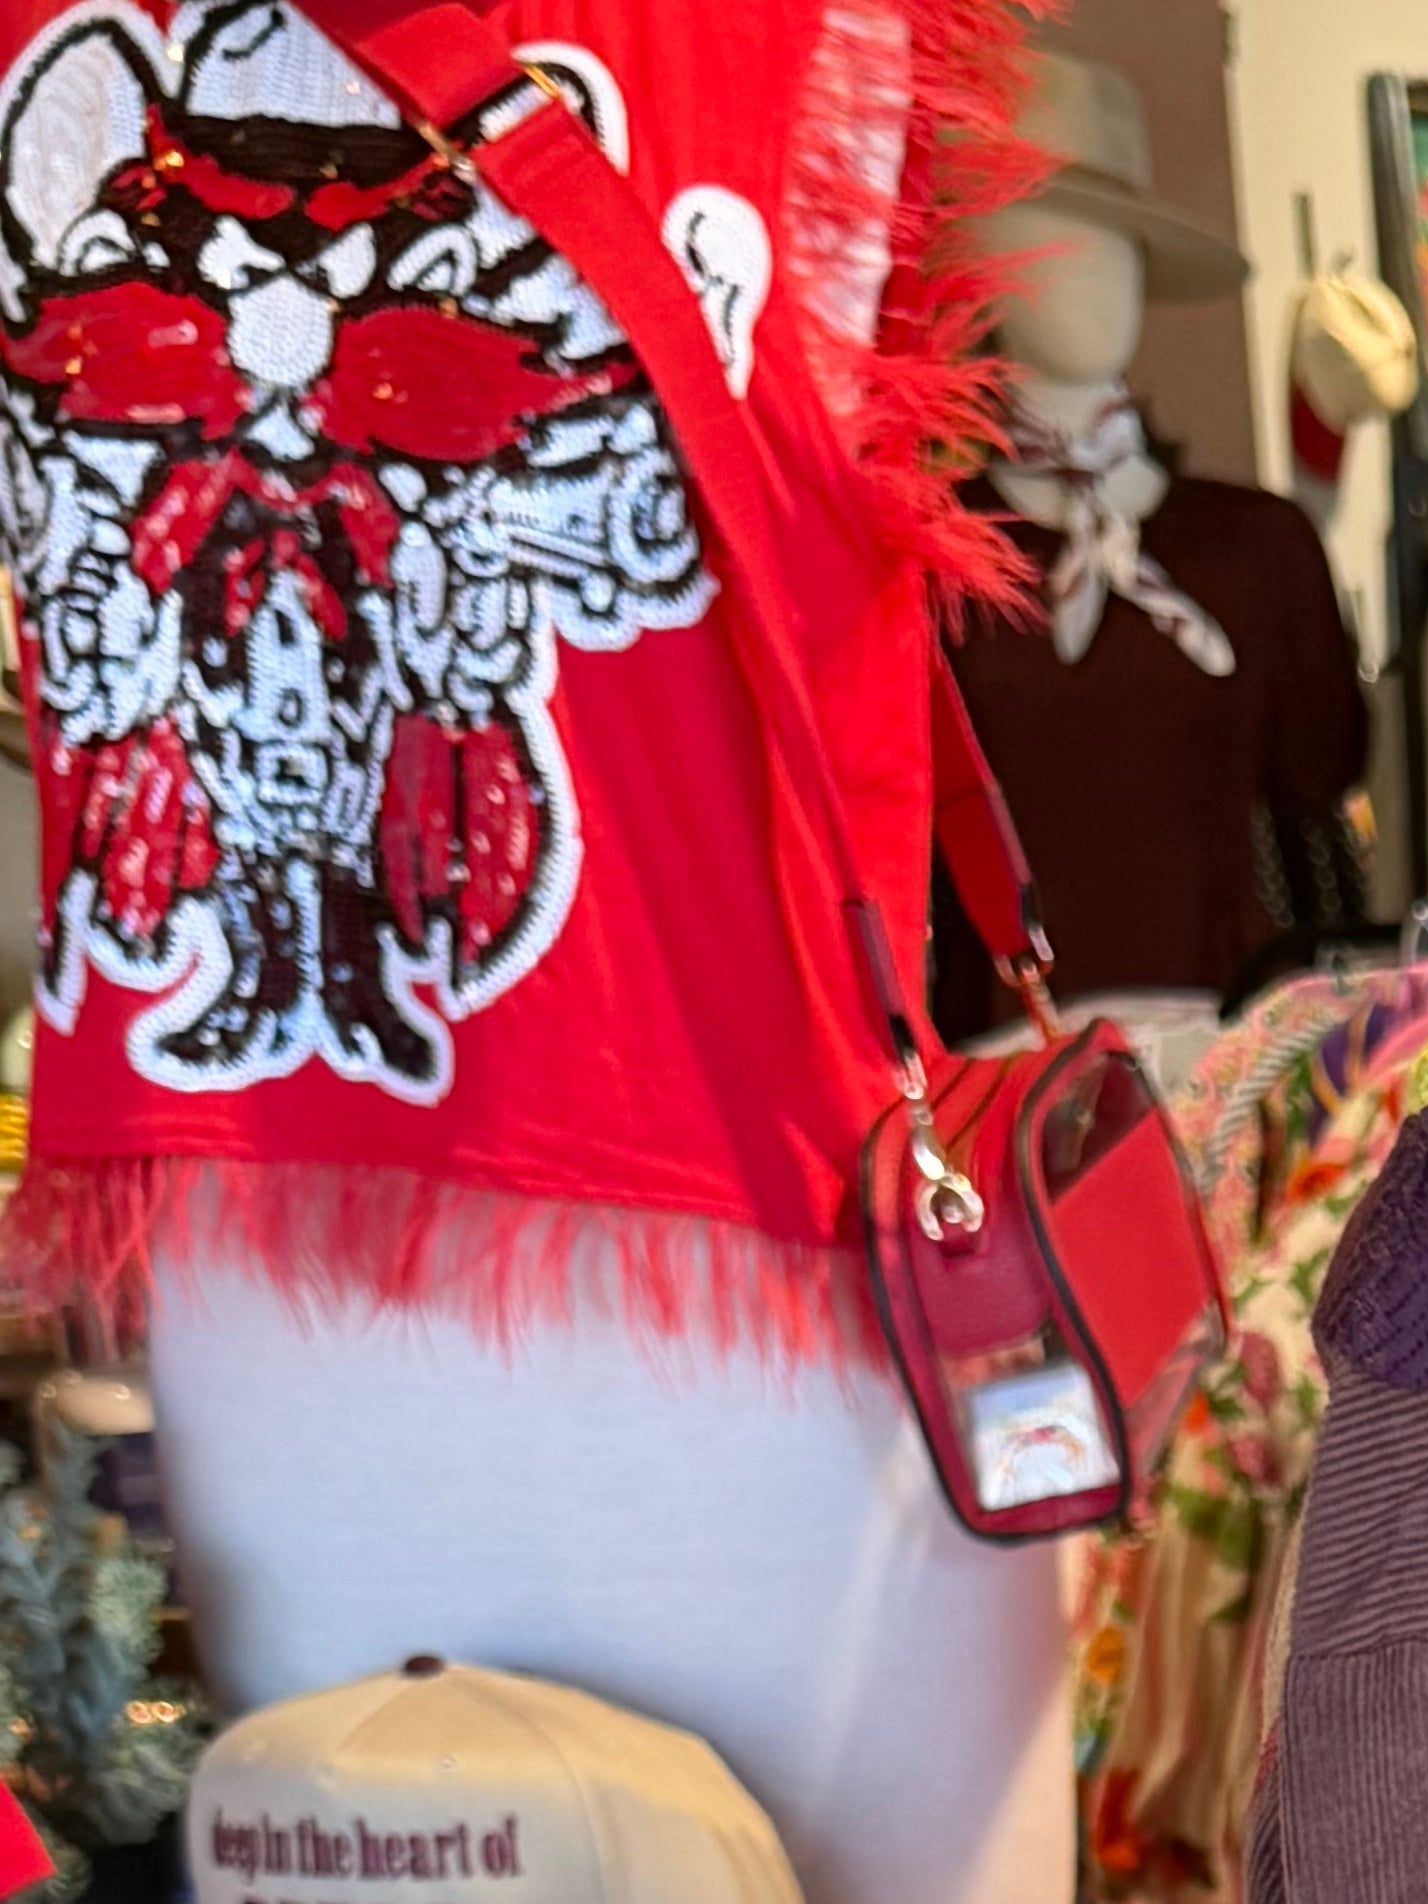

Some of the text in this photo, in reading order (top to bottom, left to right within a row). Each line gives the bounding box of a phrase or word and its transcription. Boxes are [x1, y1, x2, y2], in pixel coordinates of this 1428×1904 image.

[296, 1815, 352, 1878] the
[355, 1816, 473, 1881] heart
[481, 1811, 524, 1878] of
